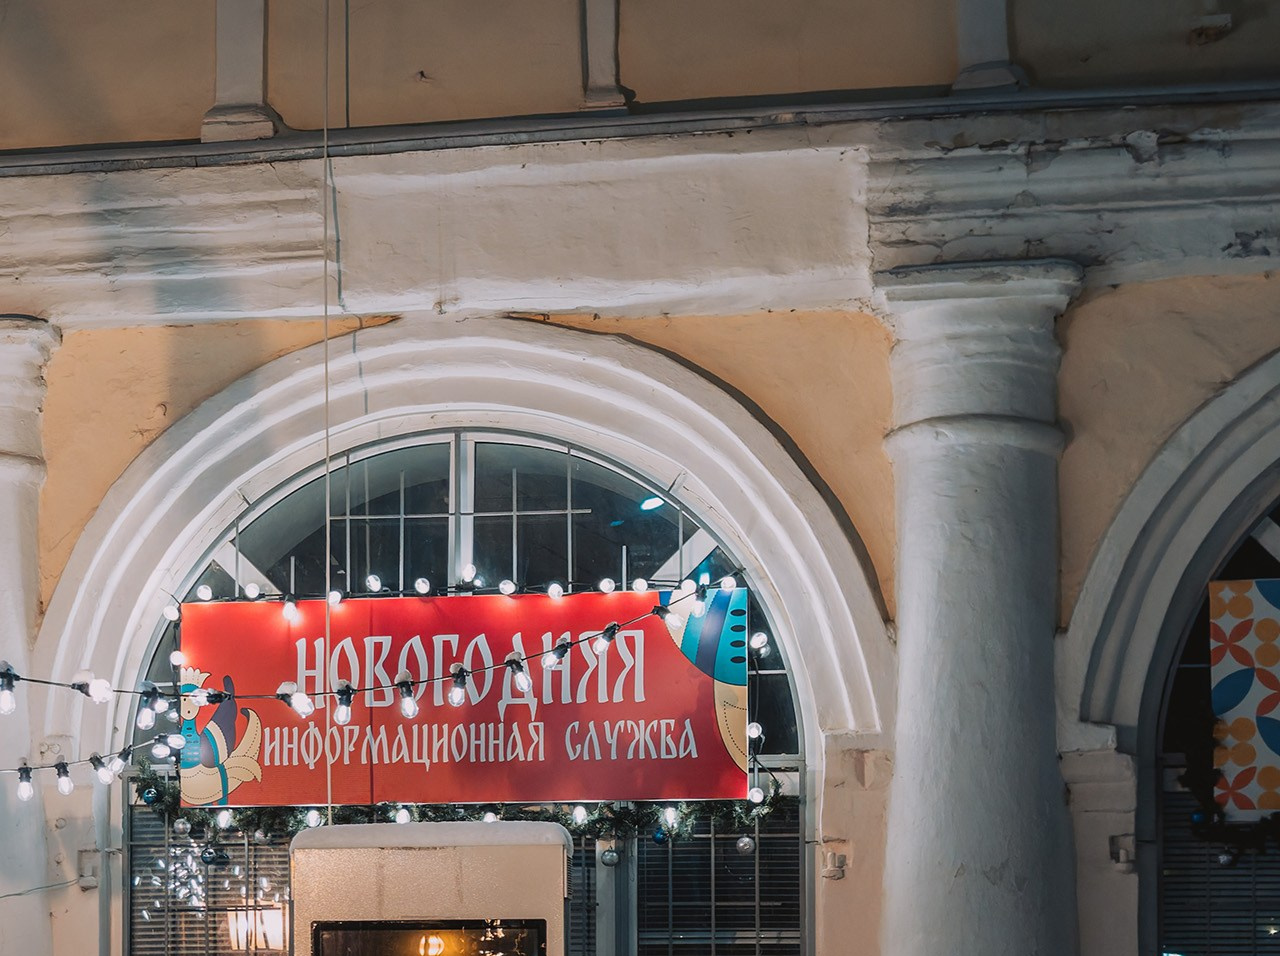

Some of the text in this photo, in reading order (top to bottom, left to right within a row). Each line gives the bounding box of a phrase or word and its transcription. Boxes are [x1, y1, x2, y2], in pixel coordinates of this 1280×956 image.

[295, 629, 645, 720] НОВОГОДНЯЯ
[263, 718, 699, 772] ИНФОРМАЦИОННАЯ СЛУЖБА
